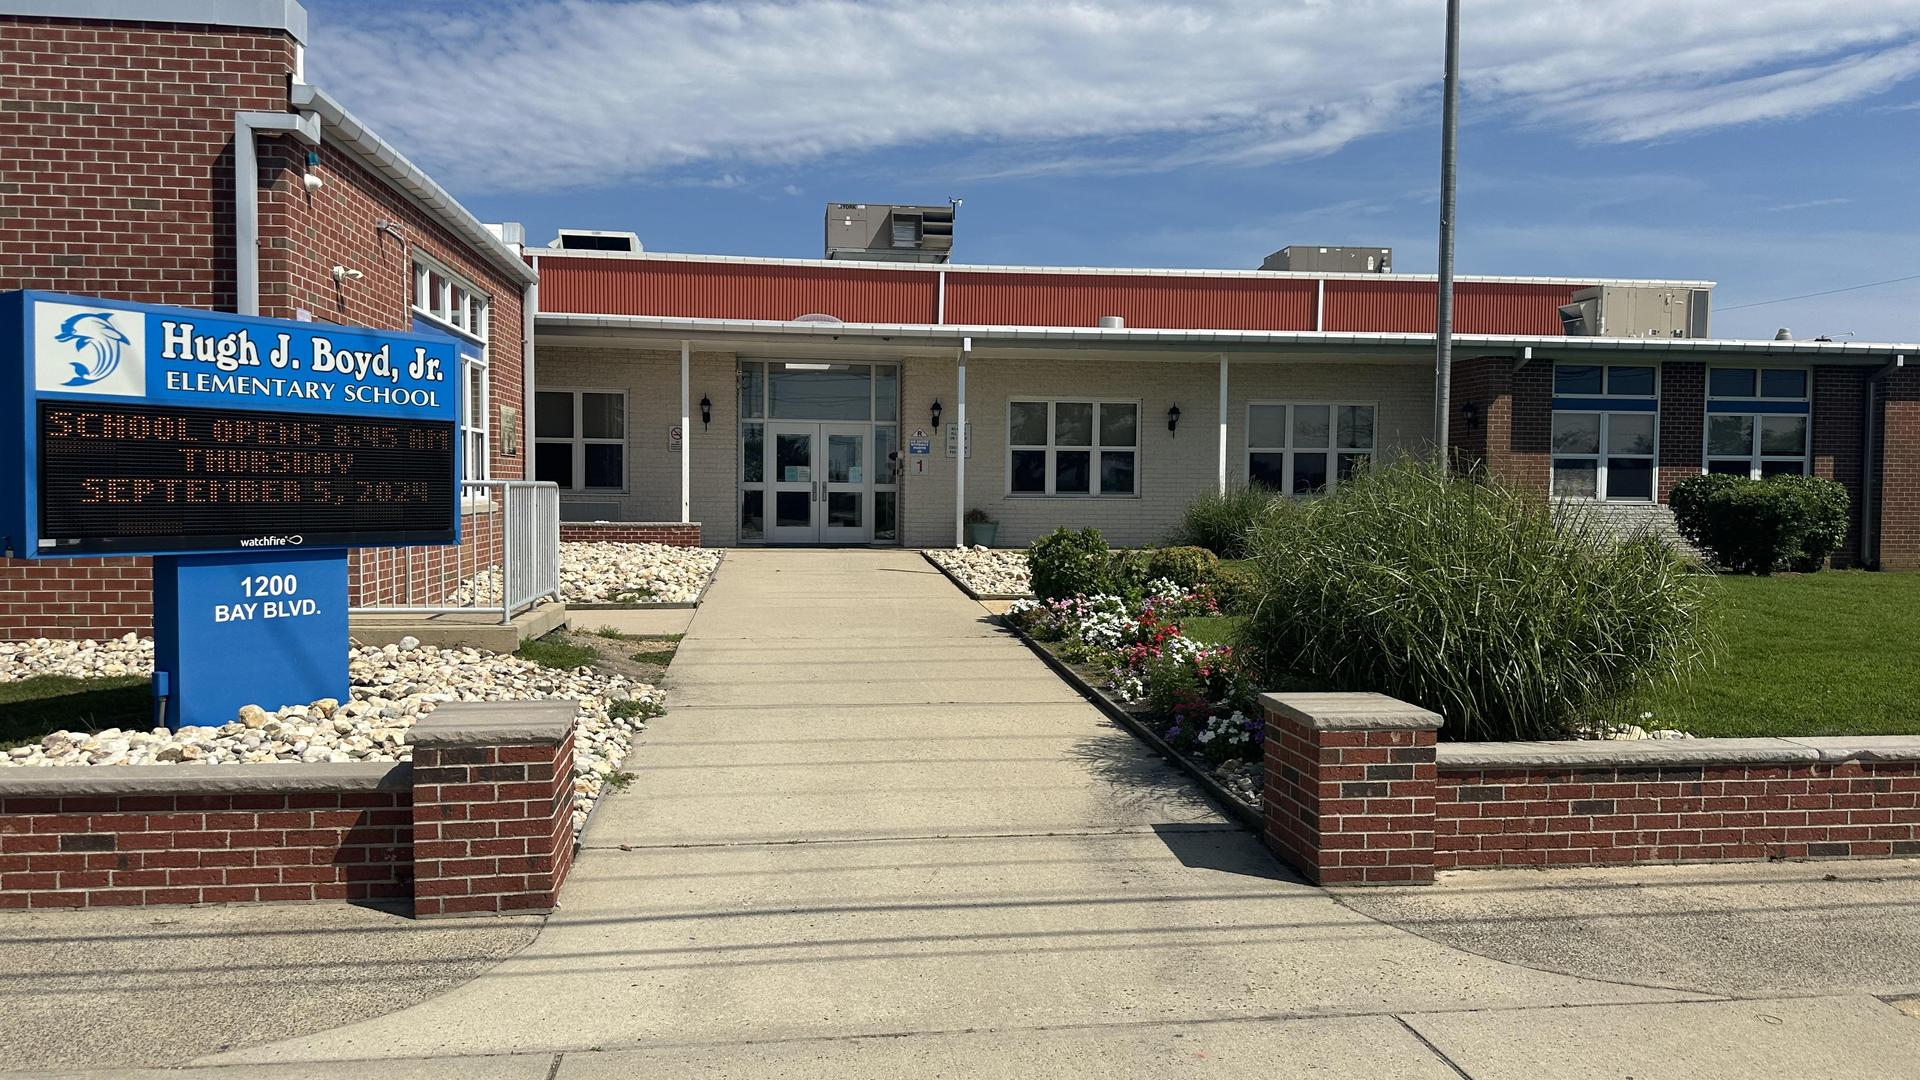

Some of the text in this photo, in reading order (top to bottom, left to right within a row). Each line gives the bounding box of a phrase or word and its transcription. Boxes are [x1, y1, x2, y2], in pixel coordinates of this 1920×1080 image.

[160, 320, 444, 384] Hugh J. Boyd, Jr.
[166, 370, 441, 408] ELEMENTARY SCHOOL
[49, 411, 448, 450] SCHOOL OPENS 8:45 AM
[178, 449, 354, 474] THURSDAY
[82, 479, 429, 505] SEPTEMBER 5, 2024
[240, 536, 286, 547] watchfire
[240, 574, 297, 598] 1200
[215, 599, 321, 623] BAY BLVD.
